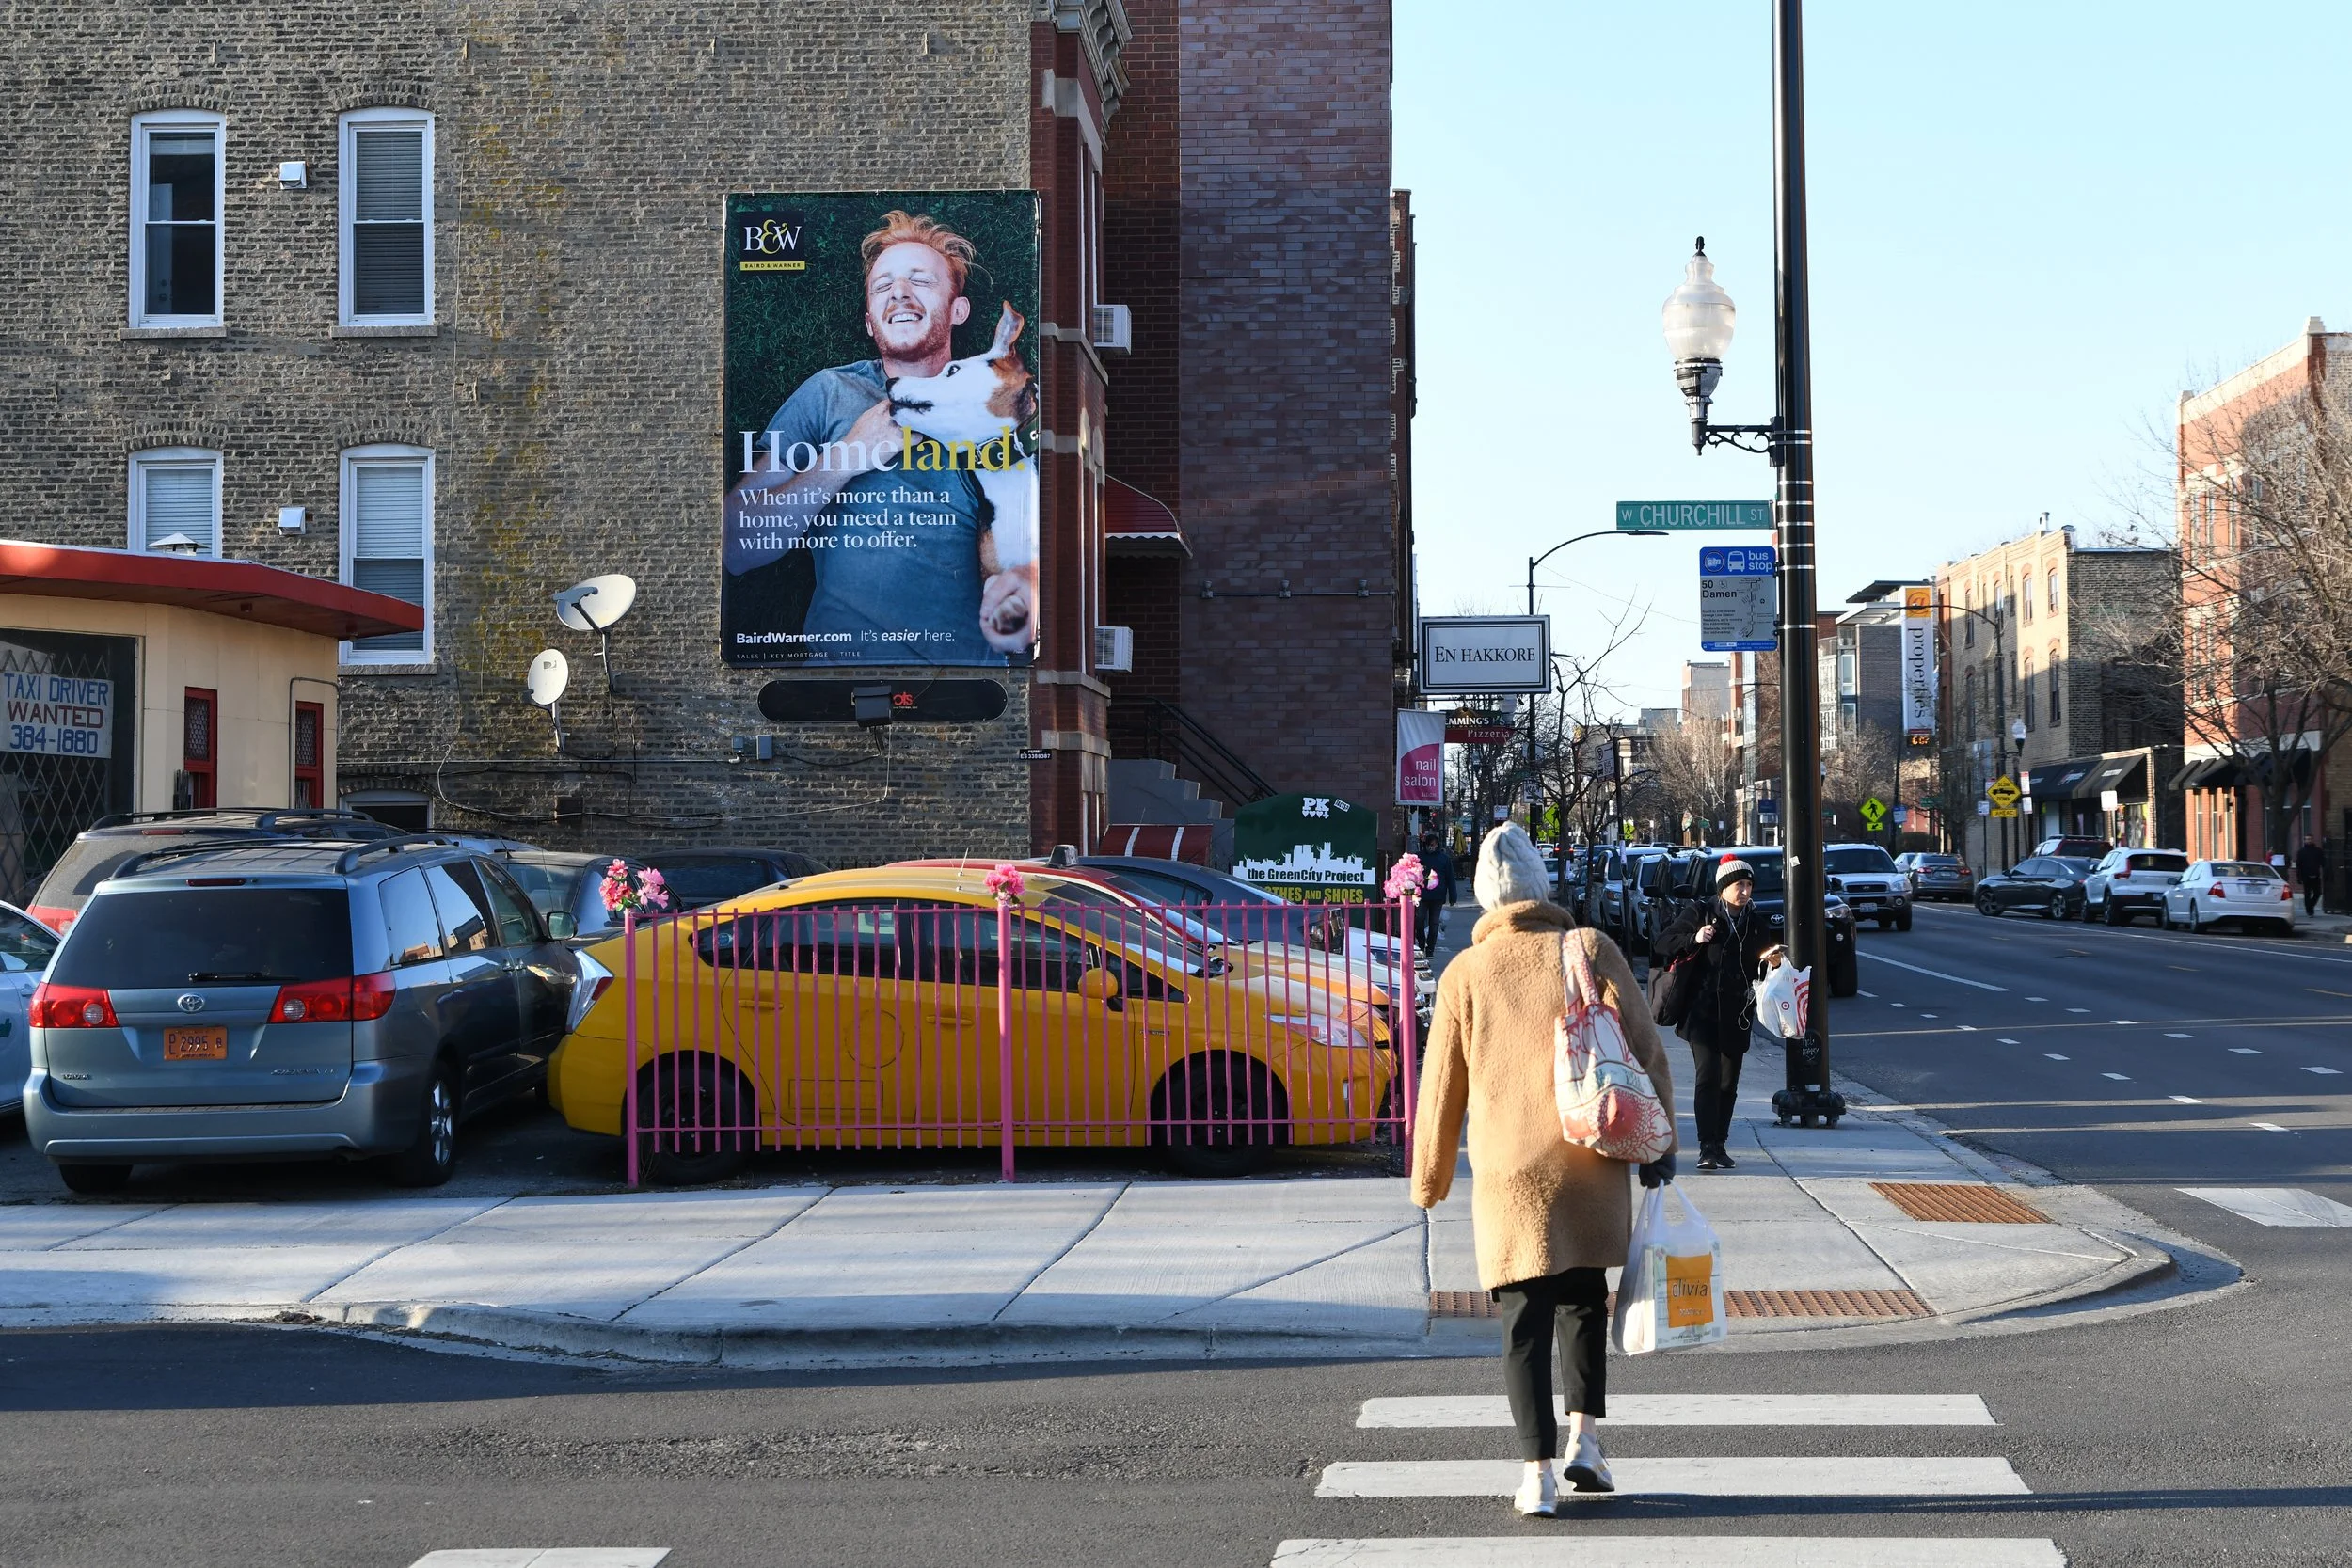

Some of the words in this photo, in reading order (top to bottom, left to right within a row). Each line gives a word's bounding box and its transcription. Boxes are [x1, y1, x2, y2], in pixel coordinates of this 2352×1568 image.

[743, 218, 803, 255] B&W
[739, 425, 1025, 473] Homeland.
[739, 488, 799, 506] When
[803, 487, 831, 506] it's
[836, 490, 886, 504] more
[891, 486, 935, 504] than
[939, 490, 950, 504] a
[739, 510, 799, 531] home,
[803, 514, 837, 533] you
[842, 509, 889, 527] need
[893, 513, 904, 526] a
[909, 511, 957, 526] team
[1621, 510, 1633, 521] W
[1639, 504, 1746, 527] CHURCHILL
[1750, 508, 1765, 521] ST
[739, 532, 783, 550] with
[787, 535, 838, 549] more
[843, 533, 864, 549] to
[867, 531, 917, 548] offer.
[1748, 550, 1769, 561] bus
[1748, 562, 1773, 573] stop
[1701, 579, 1714, 589] 50
[1702, 590, 1738, 598] Damen
[736, 630, 852, 644] BairdWarner.com
[860, 630, 878, 642] It's
[881, 629, 921, 642] easier
[924, 629, 956, 642] here.
[1461, 647, 1535, 662] HAKKORE
[4, 673, 41, 702] TAXI
[49, 677, 109, 706] DRIVER
[8, 701, 103, 729] WANTED
[9, 725, 99, 754] 384-1880
[1467, 728, 1510, 739] Pizzeria
[1415, 758, 1437, 771] nail
[1404, 773, 1437, 787] salon
[1301, 797, 1330, 812] PK
[1247, 867, 1266, 880] the
[1267, 865, 1323, 882] GreenCity
[1324, 870, 1365, 883] Project
[1304, 889, 1322, 900] AND
[1324, 887, 1364, 903] SHOES
[180, 1036, 209, 1052] 2995
[1672, 1278, 1708, 1298] olivia
